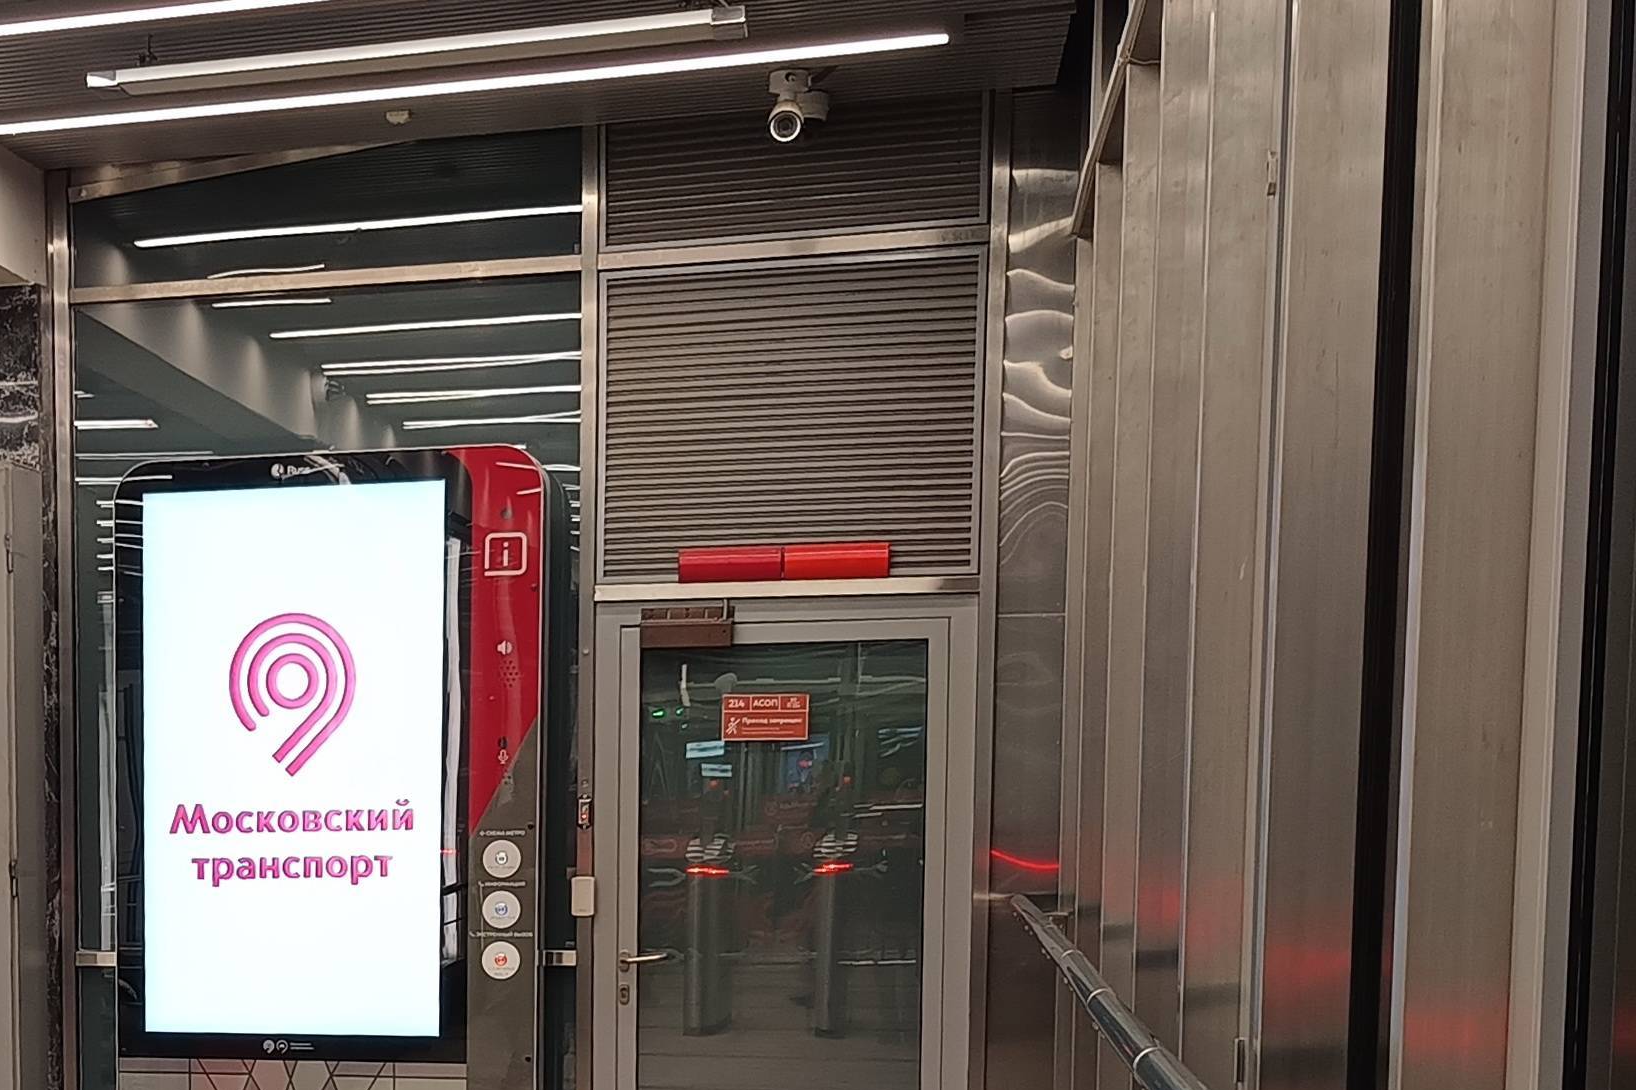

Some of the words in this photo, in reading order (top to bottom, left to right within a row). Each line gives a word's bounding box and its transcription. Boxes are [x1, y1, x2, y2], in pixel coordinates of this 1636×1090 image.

[728, 699, 745, 708] 214
[752, 698, 779, 708] АСОП
[169, 798, 414, 834] Московский
[191, 854, 393, 888] транспорт
